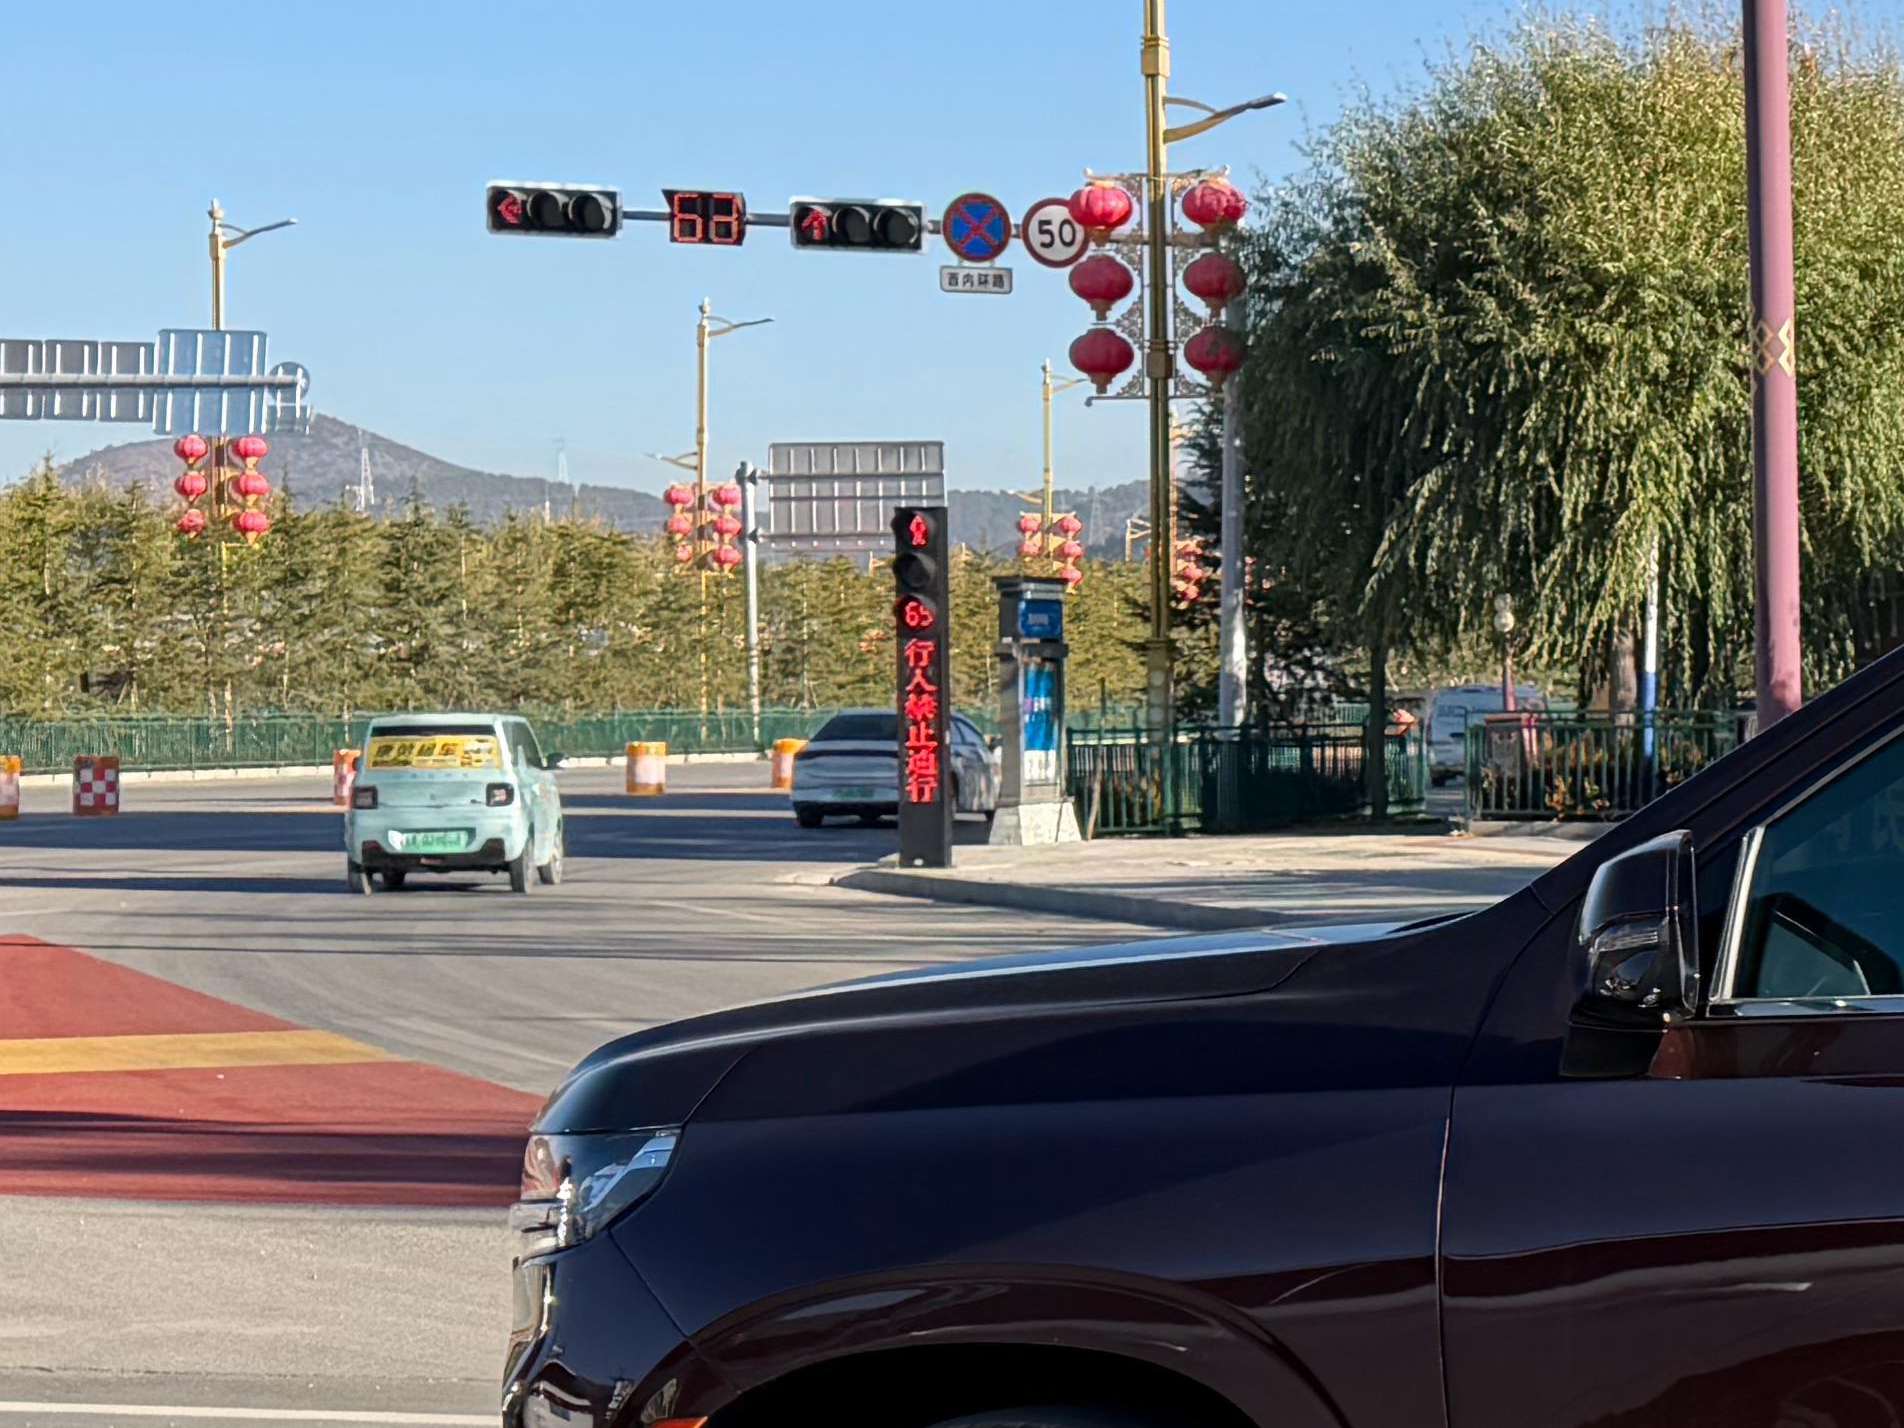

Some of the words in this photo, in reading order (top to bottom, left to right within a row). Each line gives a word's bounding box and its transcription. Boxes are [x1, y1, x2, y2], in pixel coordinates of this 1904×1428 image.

[1037, 219, 1077, 249] 50
[904, 600, 934, 627] 65
[904, 638, 938, 803] 行人禁止通行
